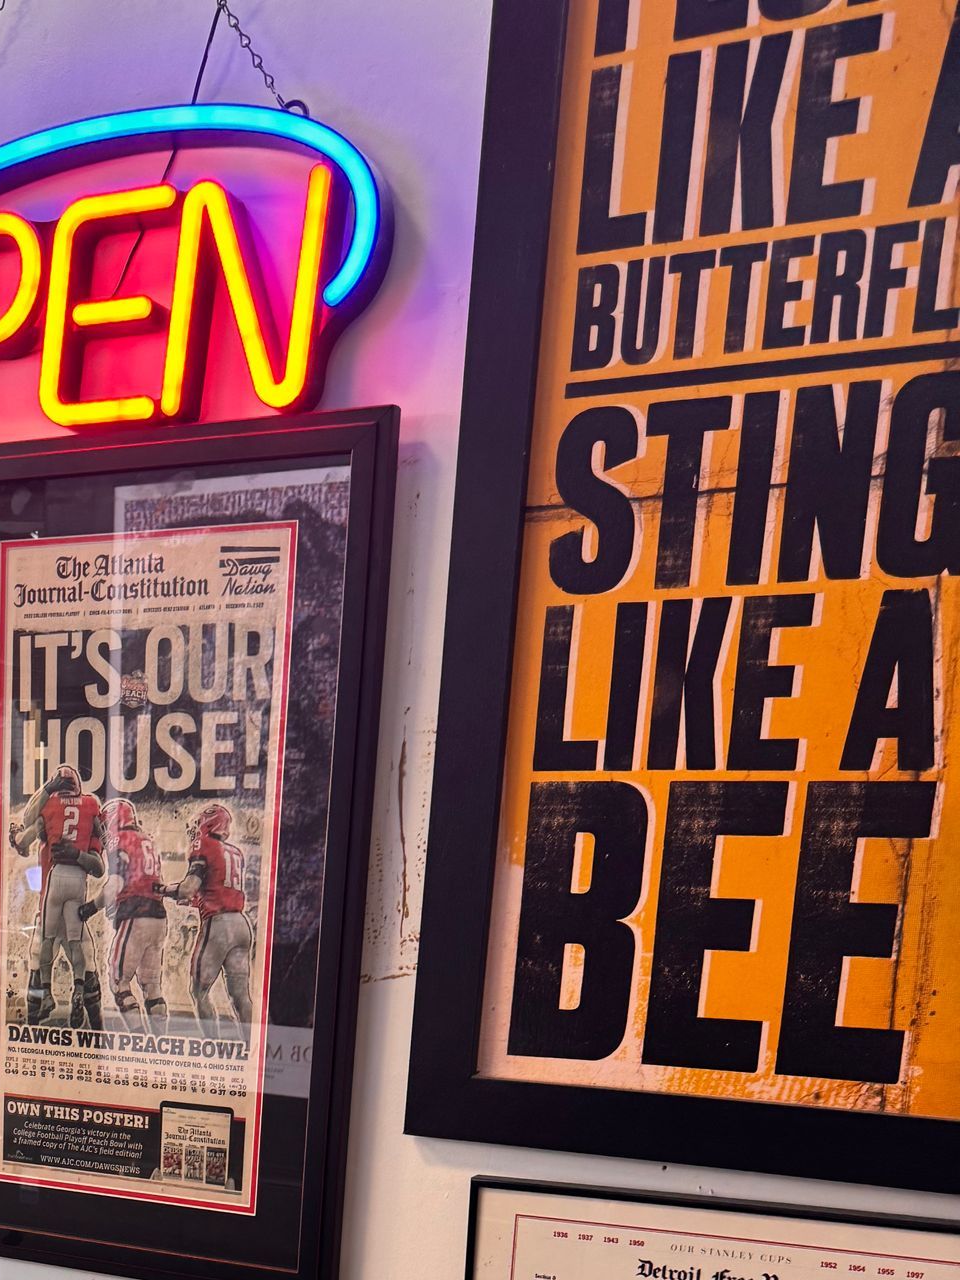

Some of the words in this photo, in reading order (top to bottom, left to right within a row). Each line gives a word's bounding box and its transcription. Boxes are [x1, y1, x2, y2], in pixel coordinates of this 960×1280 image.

[576, 15, 883, 254] LIKE
[548, 371, 960, 595] STING
[56, 556, 90, 582] The
[93, 553, 164, 578] Atlanta
[222, 559, 272, 583] Dawg
[14, 576, 209, 608] Journal-Constitution
[221, 577, 276, 597] Nation
[20, 628, 121, 712] IT'S
[146, 622, 276, 706] OUR
[533, 593, 816, 771] LIKE
[839, 588, 936, 771] A
[22, 710, 263, 796] HOUSE!
[62, 806, 80, 841] 2
[506, 781, 938, 1085] BEE
[8, 1025, 73, 1048] DAWGS
[76, 1030, 118, 1050] WIN
[120, 1034, 186, 1058] PEACH
[188, 1039, 249, 1061] BOWL
[45, 1049, 66, 1057] ENJOYS
[66, 1051, 83, 1059] HOME
[83, 1052, 110, 1061] COOKING
[117, 1056, 149, 1064] SEMIFINAL
[149, 1058, 175, 1067] VICTORY
[208, 1063, 225, 1071] OHIO
[7, 1100, 41, 1117] OWN
[43, 1104, 80, 1121] THIS
[83, 1109, 149, 1129] POSTER!
[13, 1127, 36, 1138] College
[36, 1131, 64, 1140] Football
[64, 1134, 88, 1144] Playoff
[88, 1137, 108, 1146] Peach
[109, 1139, 127, 1149] Bowl
[127, 1141, 143, 1151] with
[24, 1121, 55, 1132] Celebrate
[56, 1124, 86, 1136] Georgia's
[87, 1128, 111, 1140] victory
[111, 1131, 118, 1139] in
[119, 1132, 132, 1141] the
[18, 1137, 41, 1147] framed
[42, 1141, 57, 1150] copy
[58, 1141, 67, 1149] of
[67, 1142, 79, 1151] The
[80, 1144, 98, 1154] AJC's
[98, 1147, 115, 1156] field
[115, 1149, 143, 1159] edition!
[40, 1154, 141, 1175] WWW.AJC.COM/DAWGSNEWS
[577, 1233, 593, 1241] 1937
[603, 1236, 619, 1244] 1943
[629, 1239, 644, 1247] 1950
[670, 1243, 694, 1254] OUR
[700, 1246, 753, 1261] STANLEY
[760, 1253, 792, 1265] CUPS
[820, 1261, 838, 1270] 1952
[848, 1264, 866, 1273] 1954
[877, 1267, 895, 1277] 1955
[906, 1271, 925, 1280] 1997
